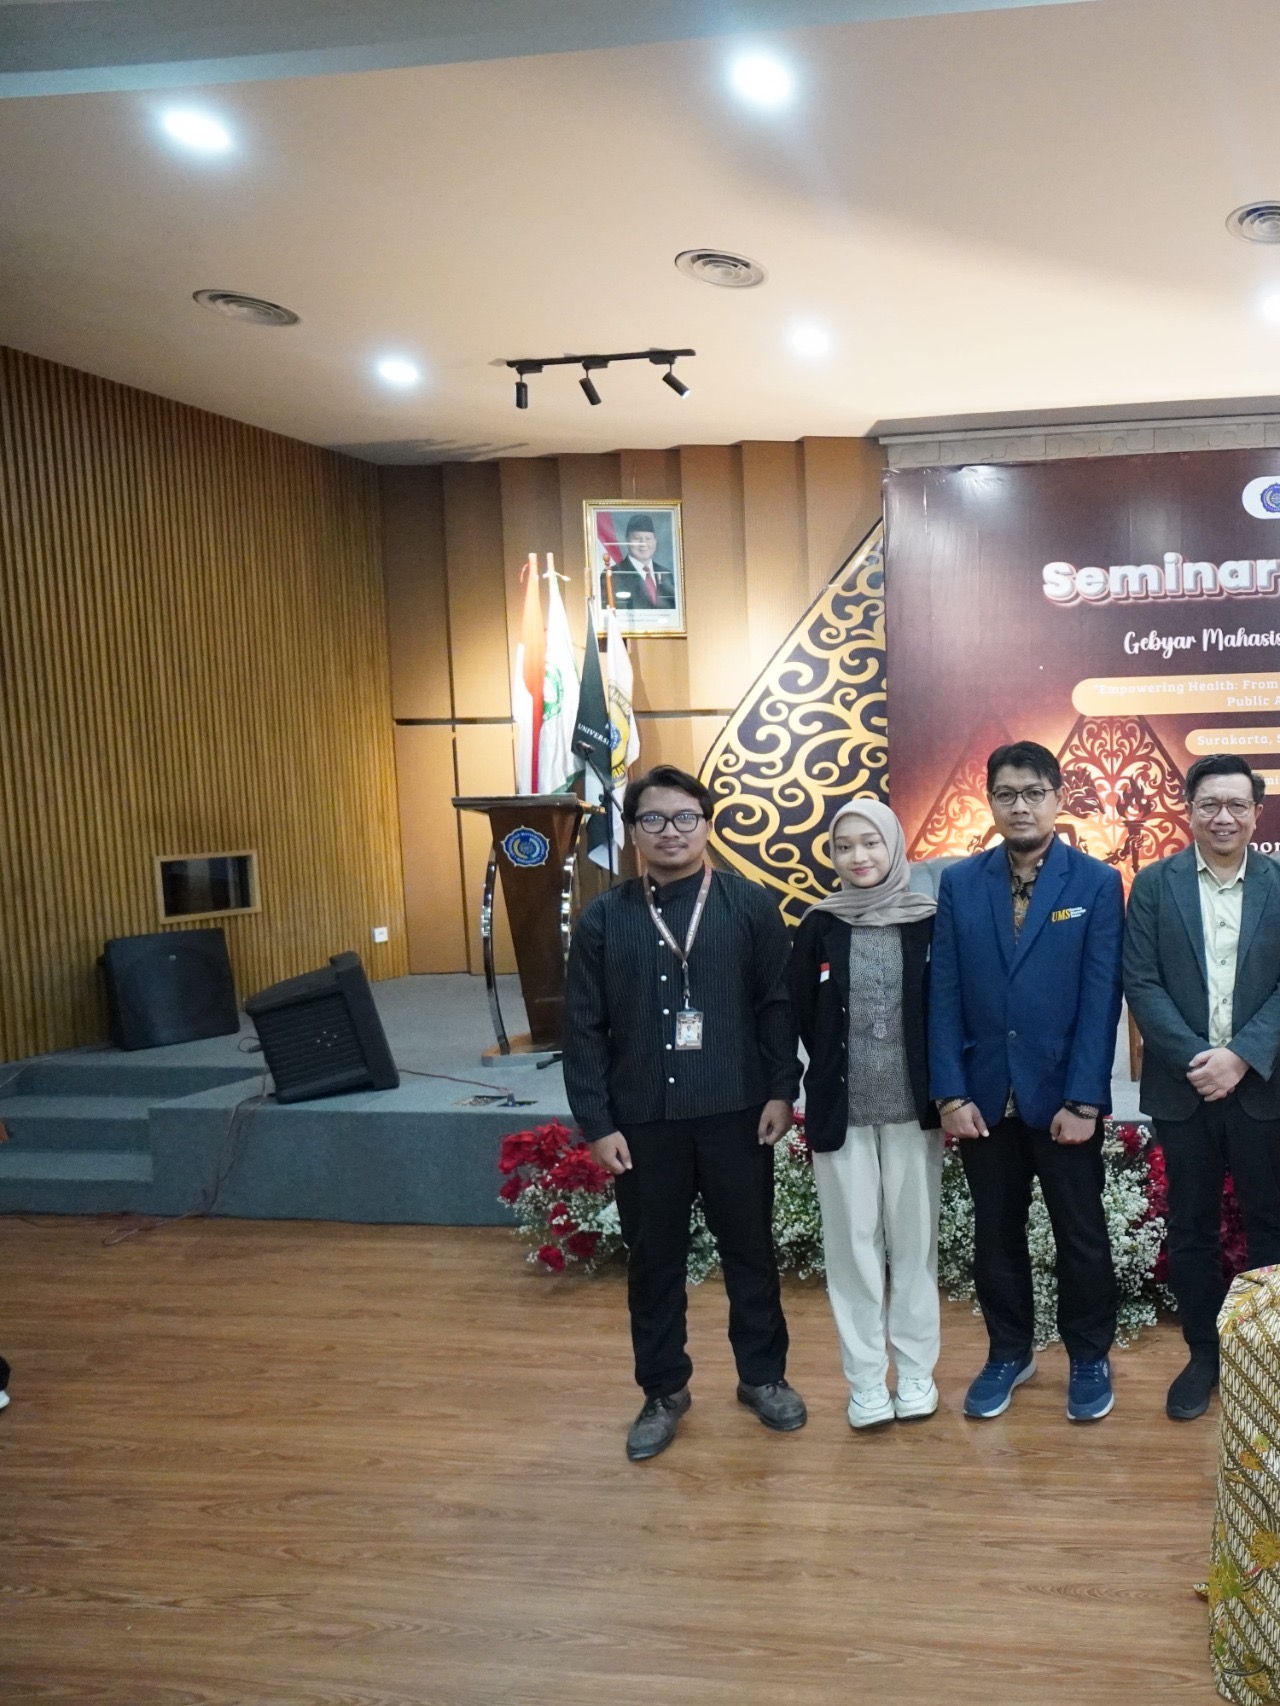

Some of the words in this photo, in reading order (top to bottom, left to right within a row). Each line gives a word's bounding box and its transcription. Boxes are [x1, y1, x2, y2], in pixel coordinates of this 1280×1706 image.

[1124, 630, 1197, 659] Gebyar
[1188, 679, 1239, 692] Health:
[1243, 679, 1279, 691] From
[1226, 694, 1270, 707] Public
[1196, 734, 1273, 747] Surakarta,
[1052, 909, 1071, 922] UMS
